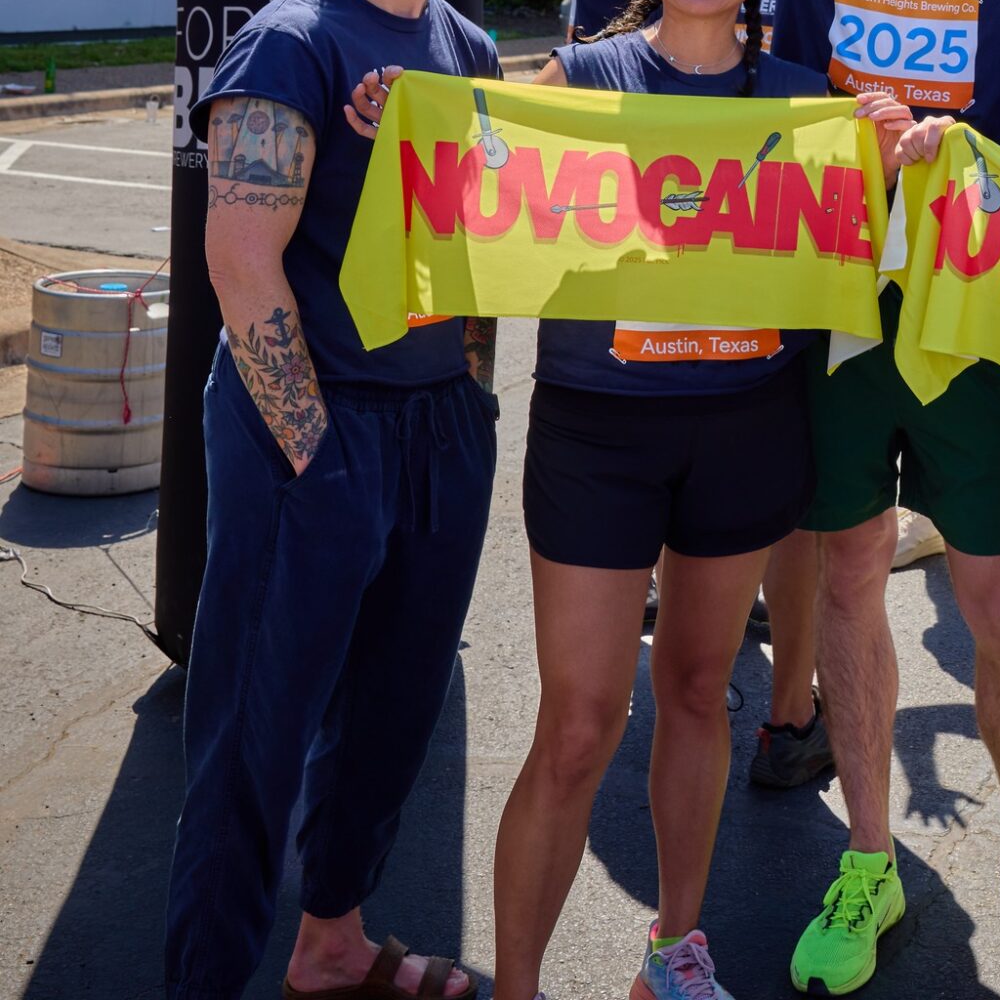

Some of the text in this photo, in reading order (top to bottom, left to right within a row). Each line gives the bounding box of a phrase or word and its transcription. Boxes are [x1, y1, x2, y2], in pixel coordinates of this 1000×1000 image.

[920, 1, 960, 13] Brewing
[961, 3, 977, 13] Co.
[836, 14, 969, 74] 2025
[904, 84, 951, 102] Texas
[640, 336, 759, 355] Austin, Texas
